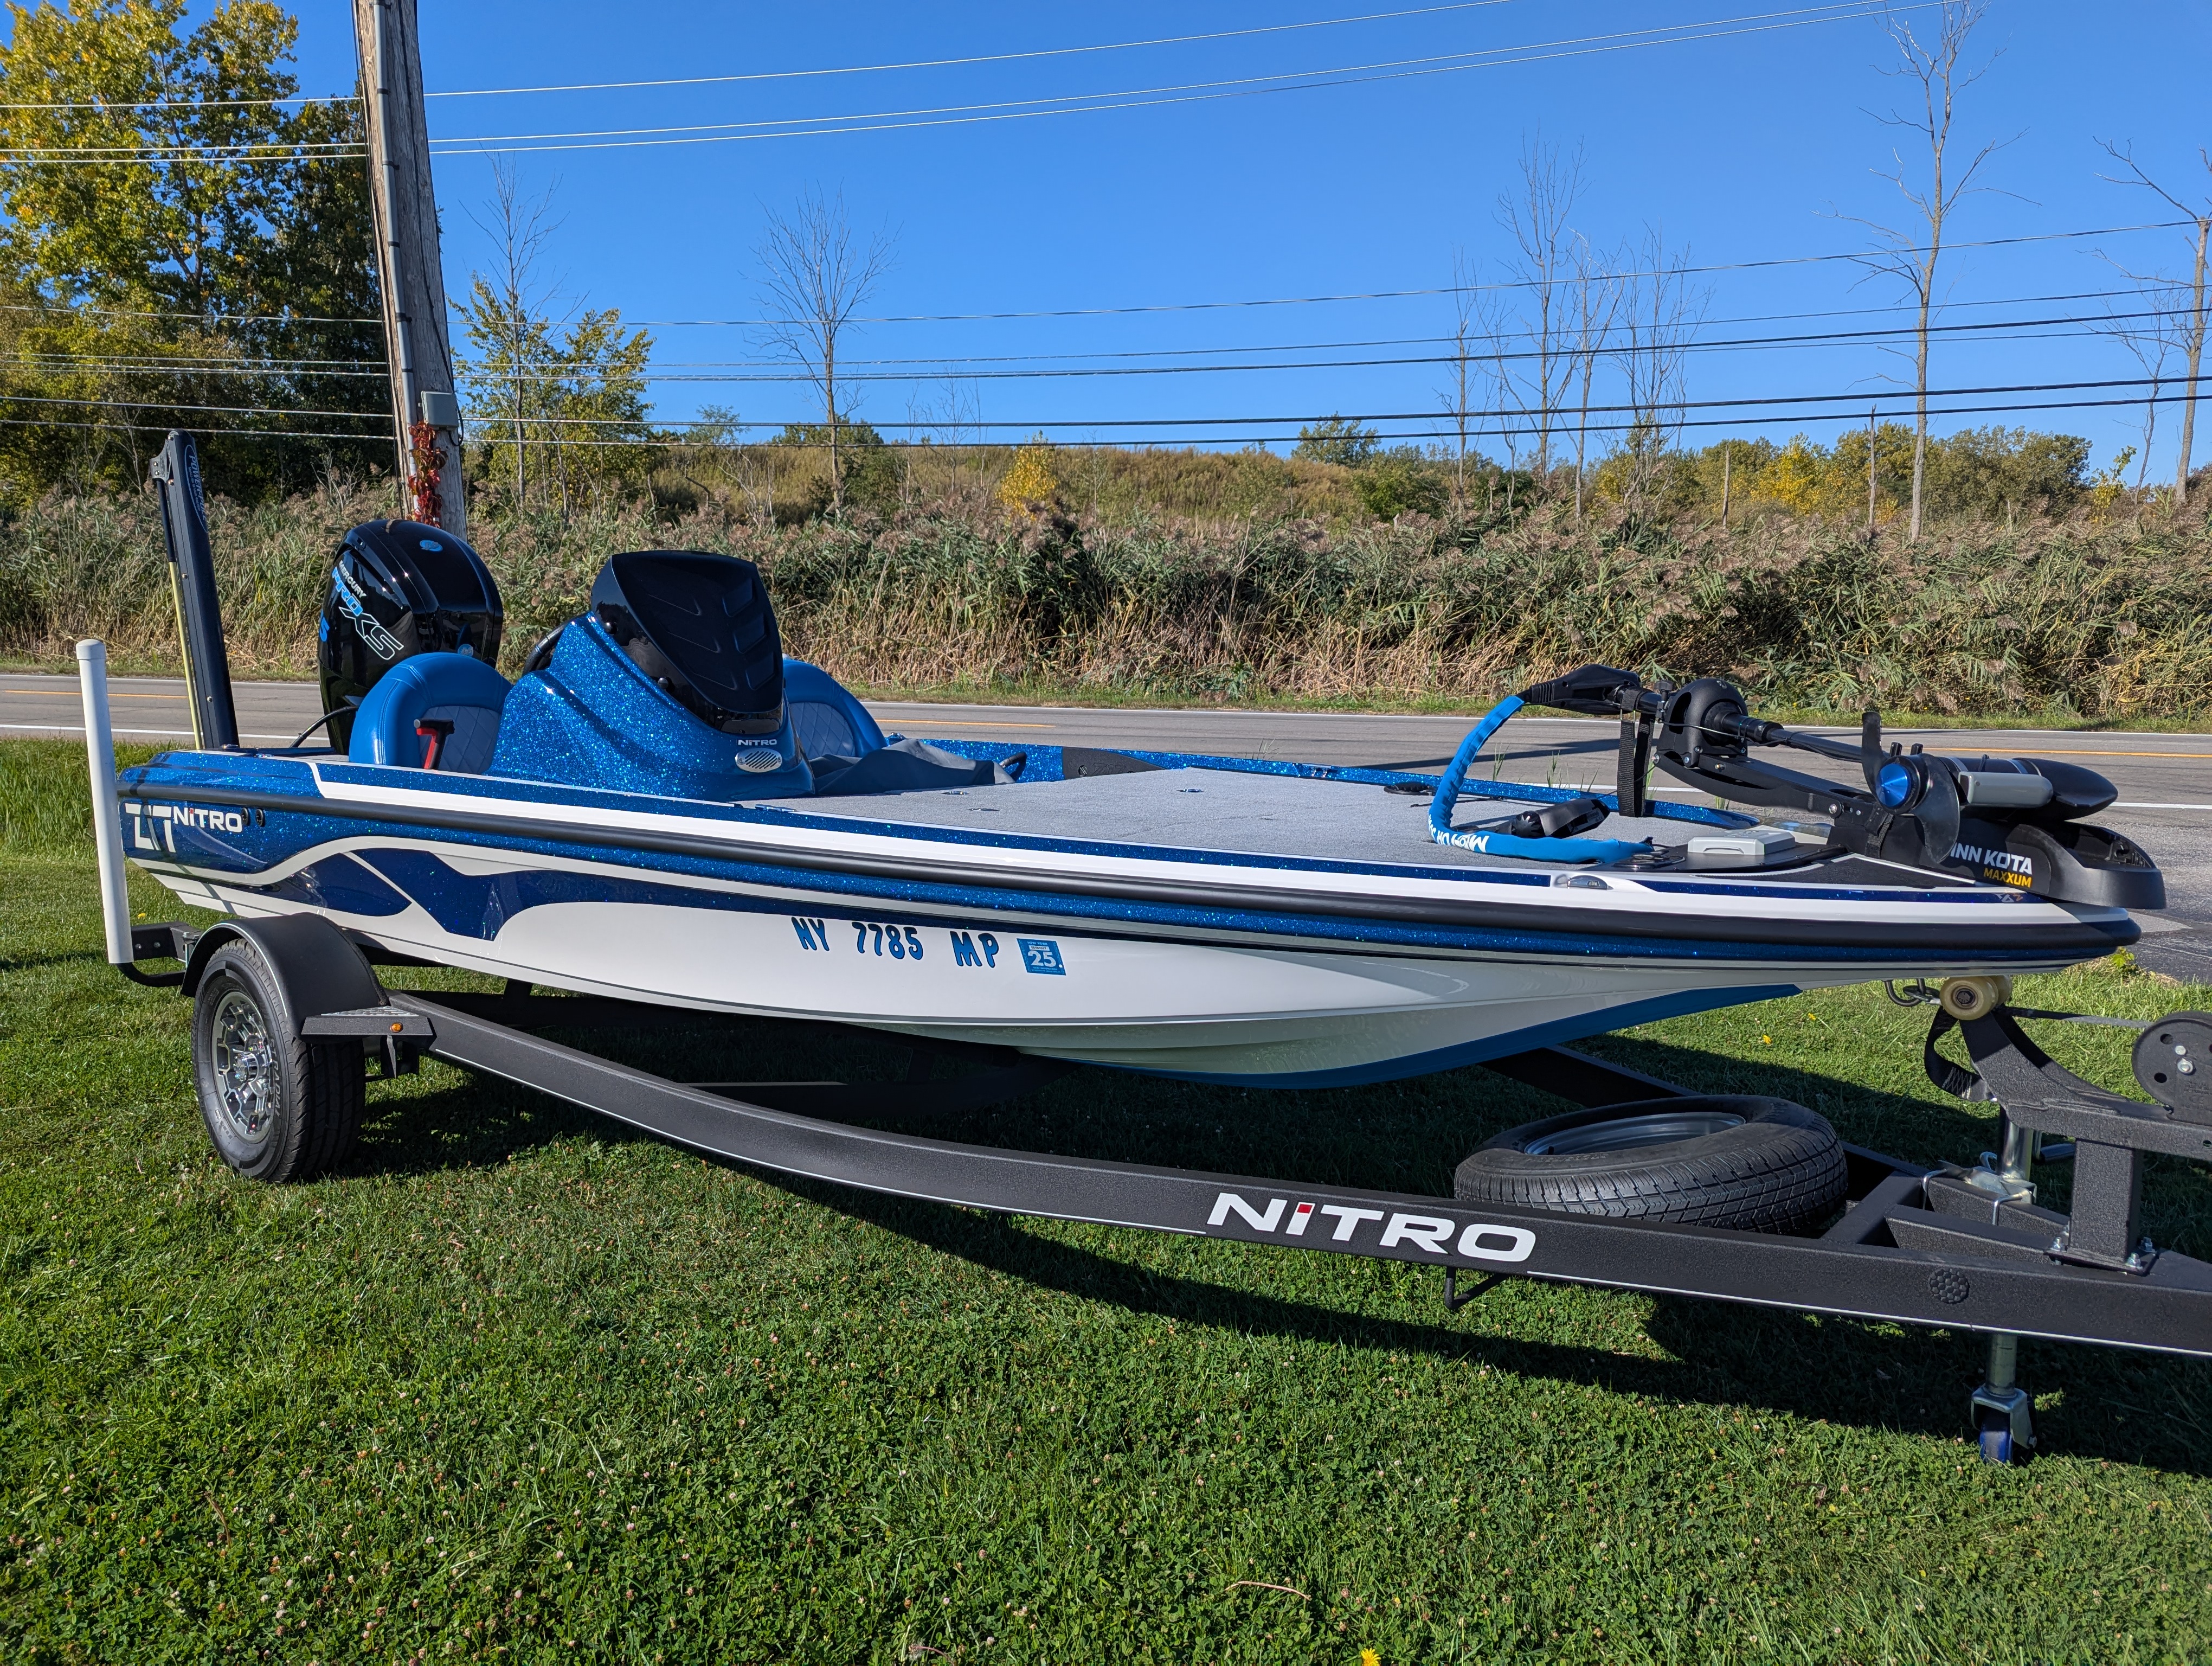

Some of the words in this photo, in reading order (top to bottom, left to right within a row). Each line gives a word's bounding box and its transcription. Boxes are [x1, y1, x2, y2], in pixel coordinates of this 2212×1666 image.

[189, 455, 207, 521] POWER-POLE
[332, 566, 363, 617] PRO
[338, 560, 366, 598] MERCURY
[338, 606, 404, 660] XS
[1950, 842, 1983, 863] INN
[1984, 849, 2033, 875] KOTA
[1983, 867, 2033, 888] MAXXUM
[791, 917, 829, 951] NY
[851, 921, 923, 960] 7785
[950, 931, 999, 968] MP
[1027, 950, 1057, 967] 25
